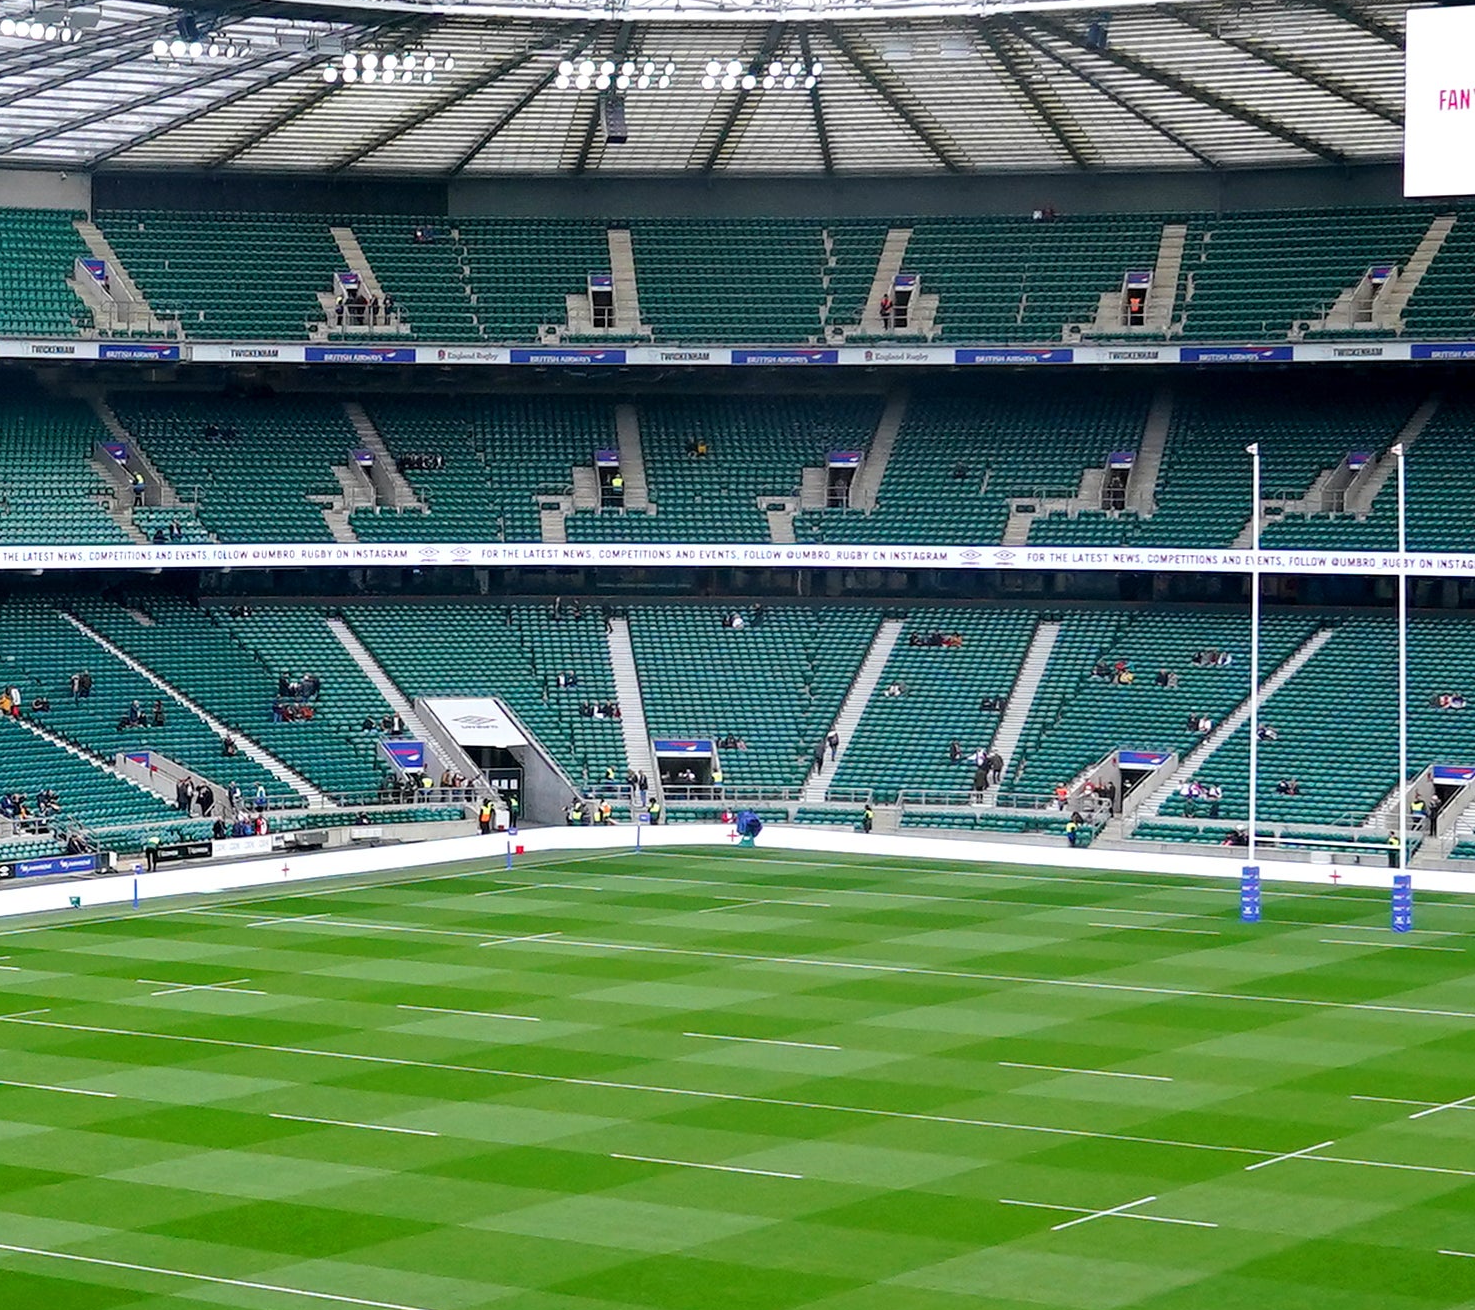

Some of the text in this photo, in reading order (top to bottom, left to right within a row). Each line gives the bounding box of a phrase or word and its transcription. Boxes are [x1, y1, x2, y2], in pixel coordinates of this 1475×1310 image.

[1028, 553, 1044, 562] FOR
[1051, 553, 1067, 562] THE
[1073, 554, 1107, 562] LATEST
[1114, 554, 1143, 564] NEWS,
[1148, 554, 1217, 564] COMPETITIONS
[1222, 556, 1240, 565] AND
[1290, 557, 1326, 566] FOLLOW
[1420, 559, 1432, 568] ON
